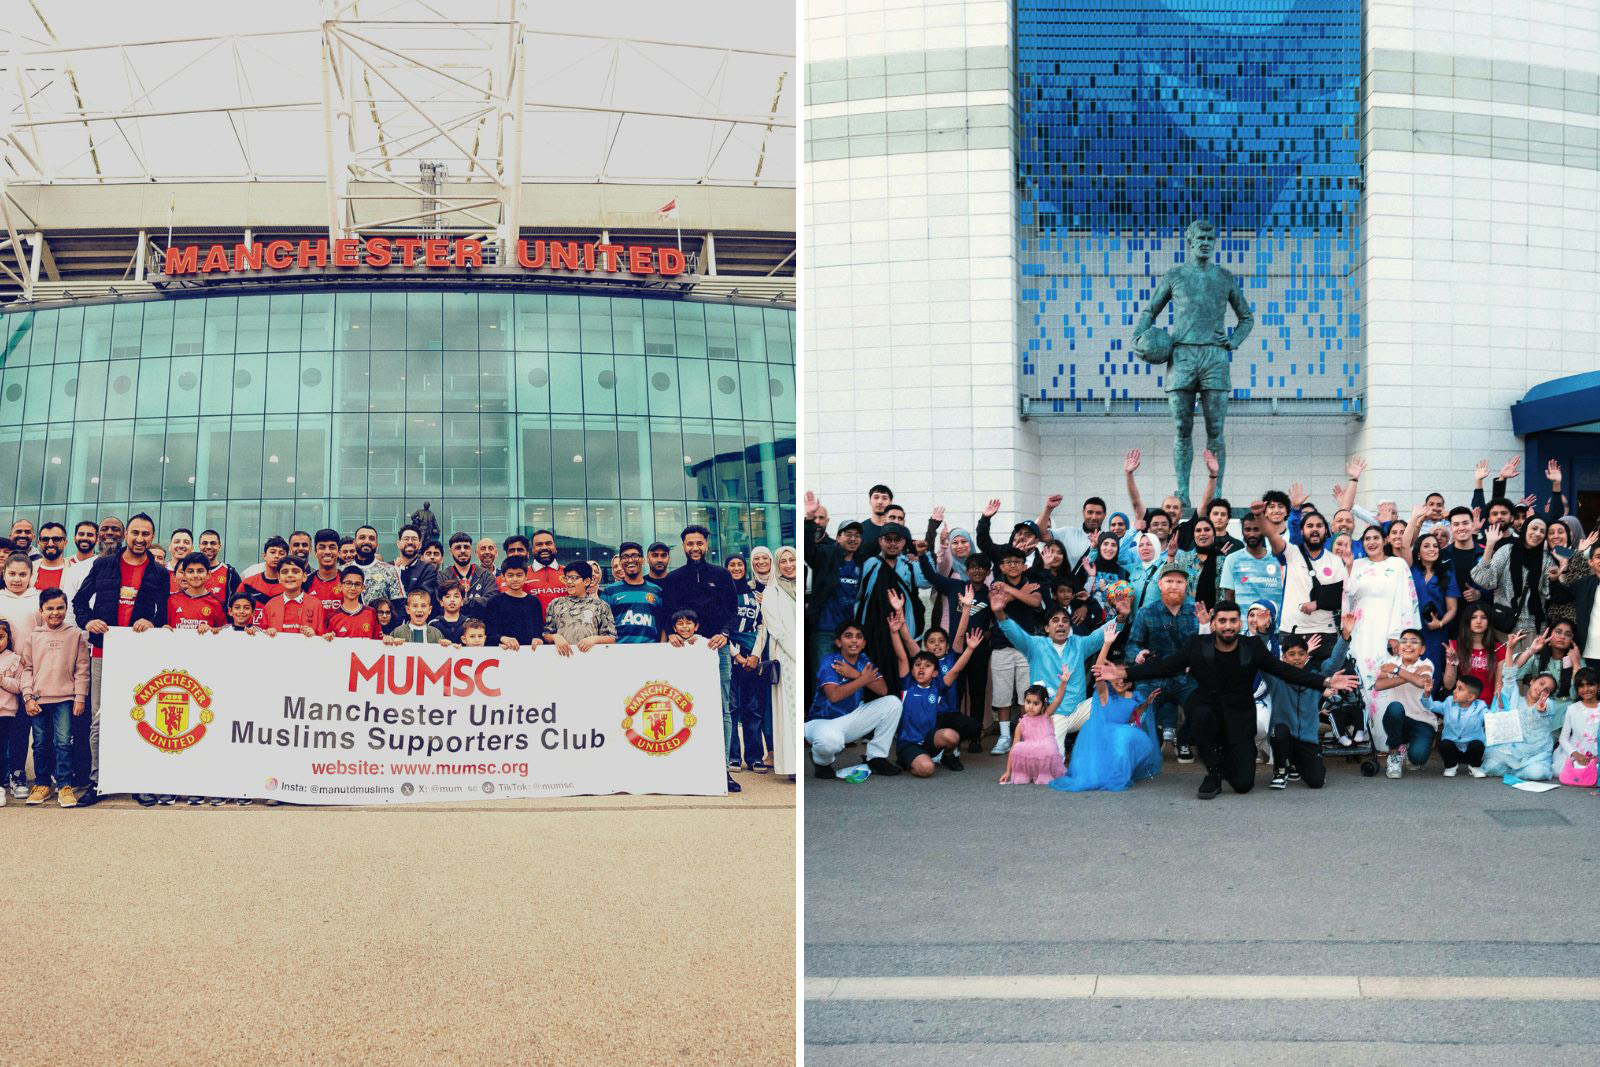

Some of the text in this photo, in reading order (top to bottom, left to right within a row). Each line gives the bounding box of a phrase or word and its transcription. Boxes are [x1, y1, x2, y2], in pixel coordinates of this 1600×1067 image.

[165, 238, 686, 277] MANCHESTER UNITED
[530, 587, 568, 595] SHARP
[621, 610, 652, 626] AON
[348, 652, 501, 697] MUMSC
[140, 675, 206, 703] MANCHESTER
[629, 687, 688, 712] MANCHESTER
[283, 696, 557, 726] Manchester United
[149, 733, 195, 748] UNITED
[231, 720, 605, 757] Muslims Supporters Club
[638, 738, 681, 751] UNITED
[312, 760, 529, 777] website: www.mumsc.org
[281, 782, 395, 794] Insta: @manutdmuslims
